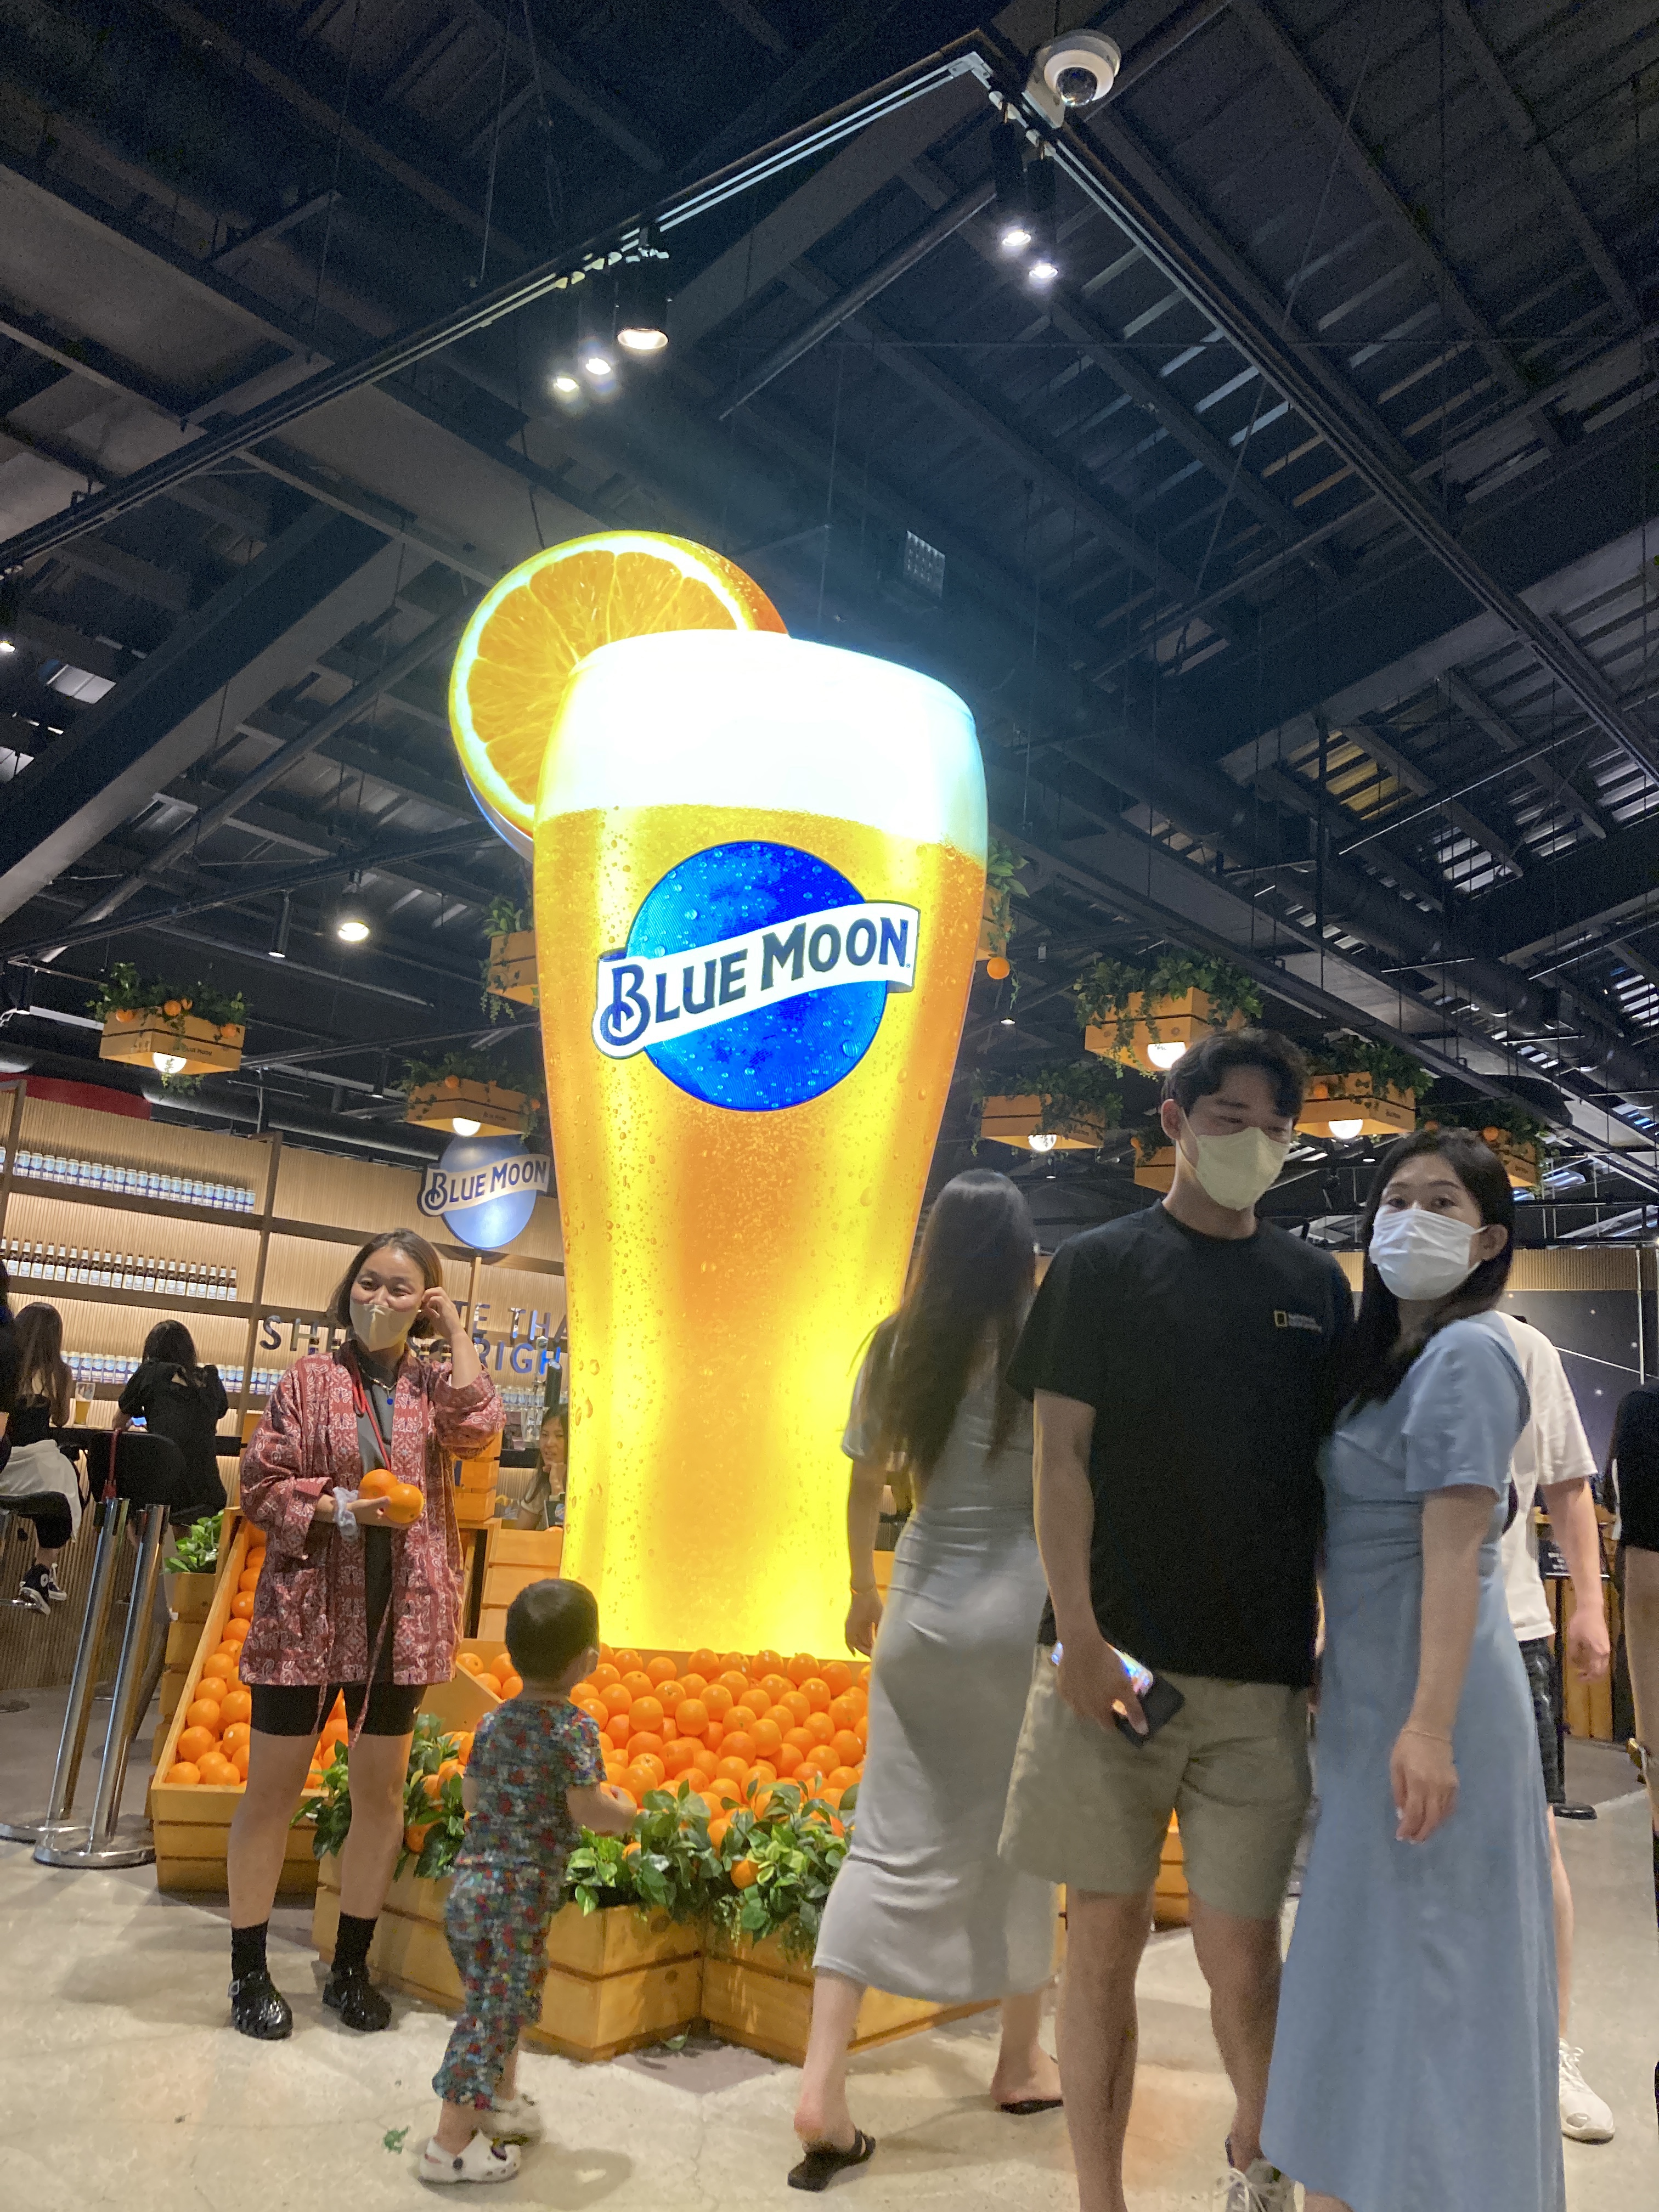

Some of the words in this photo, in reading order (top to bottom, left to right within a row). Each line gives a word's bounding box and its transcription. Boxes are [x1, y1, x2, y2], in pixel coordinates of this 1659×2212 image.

[600, 948, 748, 1046] BLUE
[760, 917, 909, 991] MOON
[425, 1172, 487, 1210] BLUE
[490, 1160, 547, 1193] MOON
